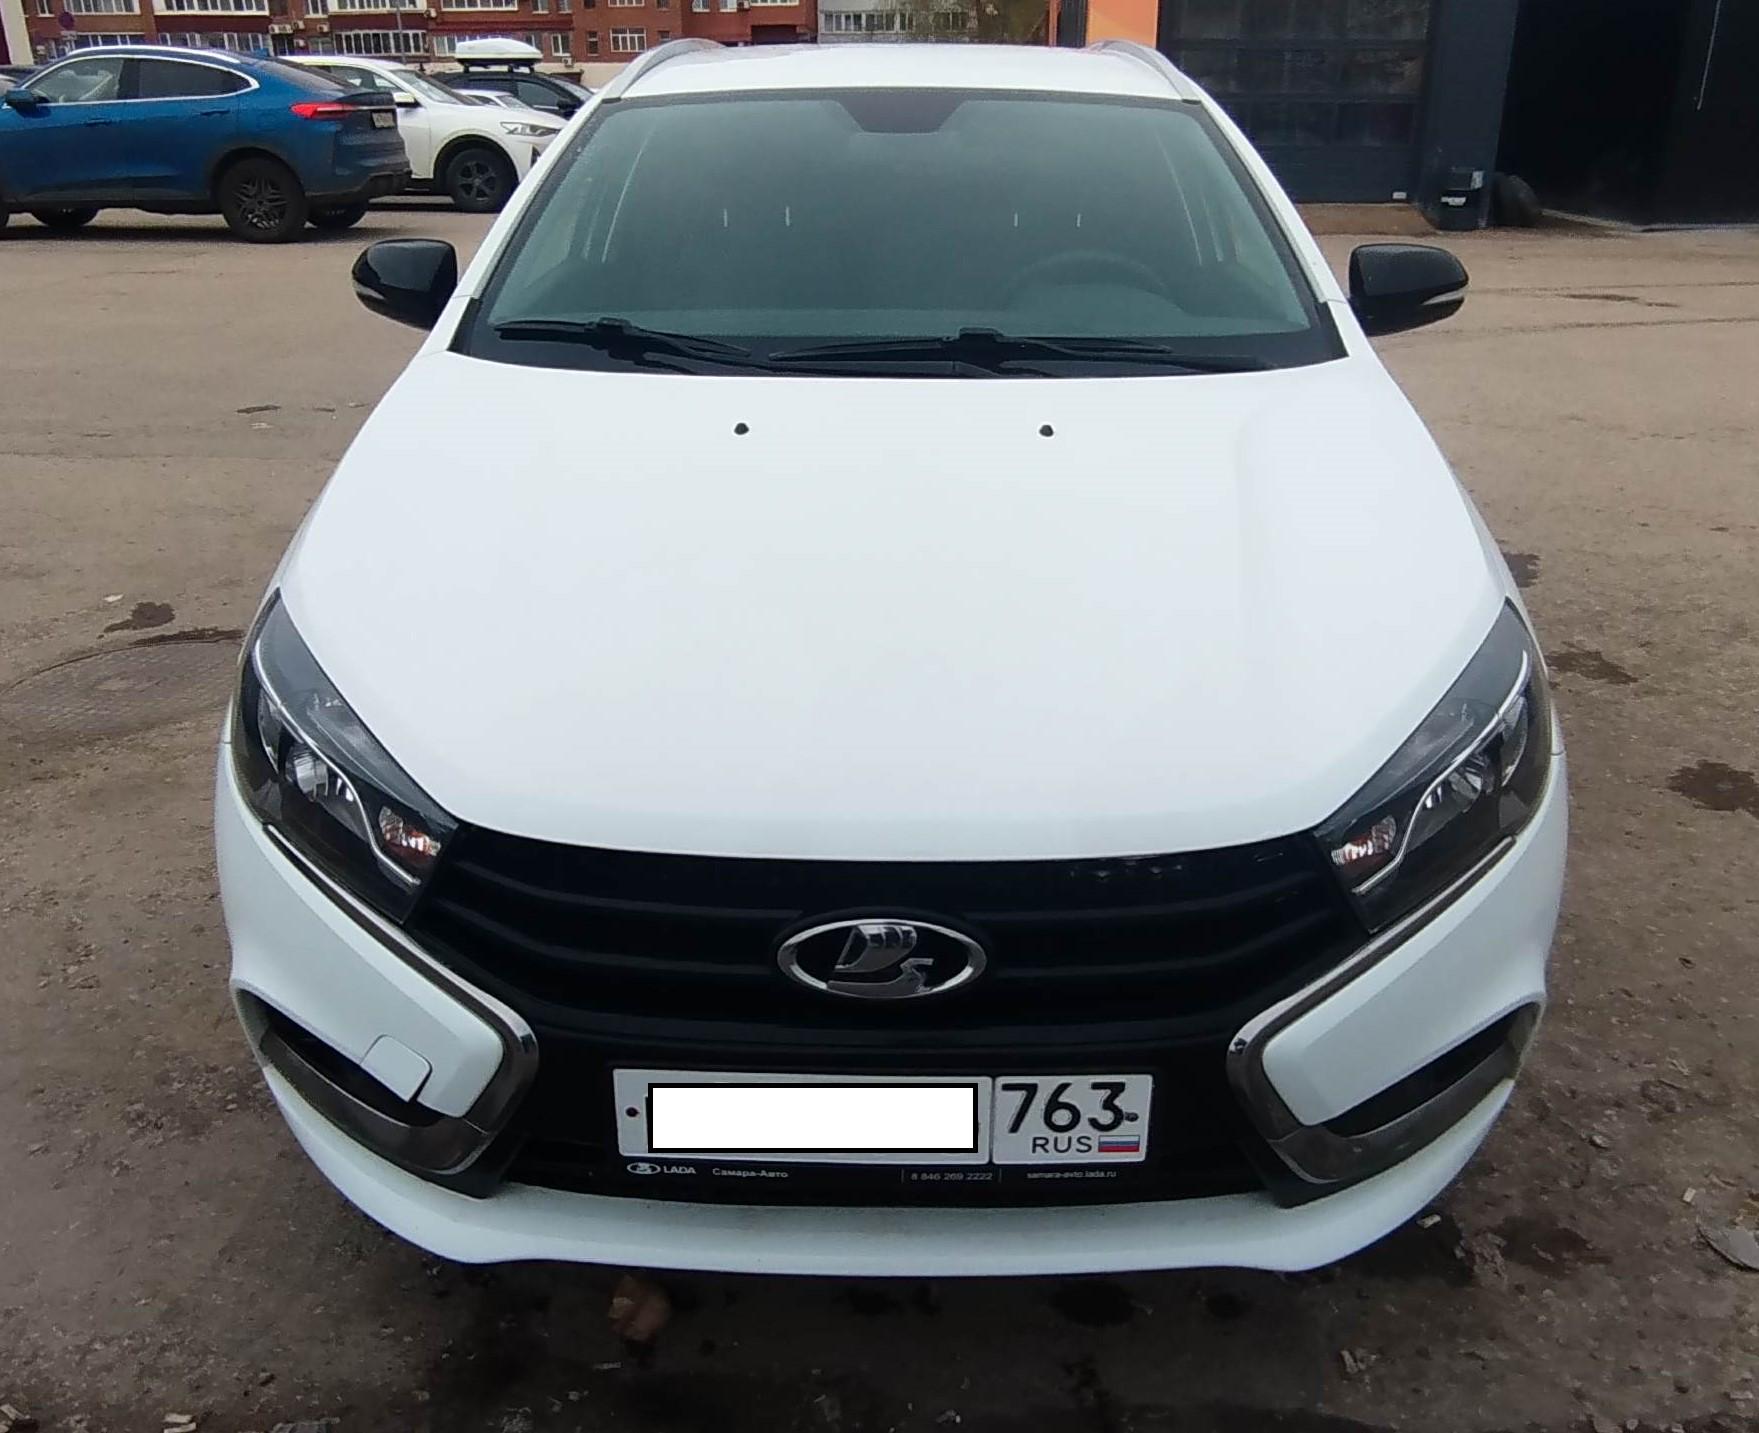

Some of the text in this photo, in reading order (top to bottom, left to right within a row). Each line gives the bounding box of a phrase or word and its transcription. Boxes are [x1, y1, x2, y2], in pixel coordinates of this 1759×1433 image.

[1001, 1081, 1125, 1134] 763
[1031, 1135, 1093, 1154] RUS
[663, 1165, 697, 1175] LADA
[712, 1167, 789, 1178] Самара-Авто
[966, 1172, 993, 1181] 2222
